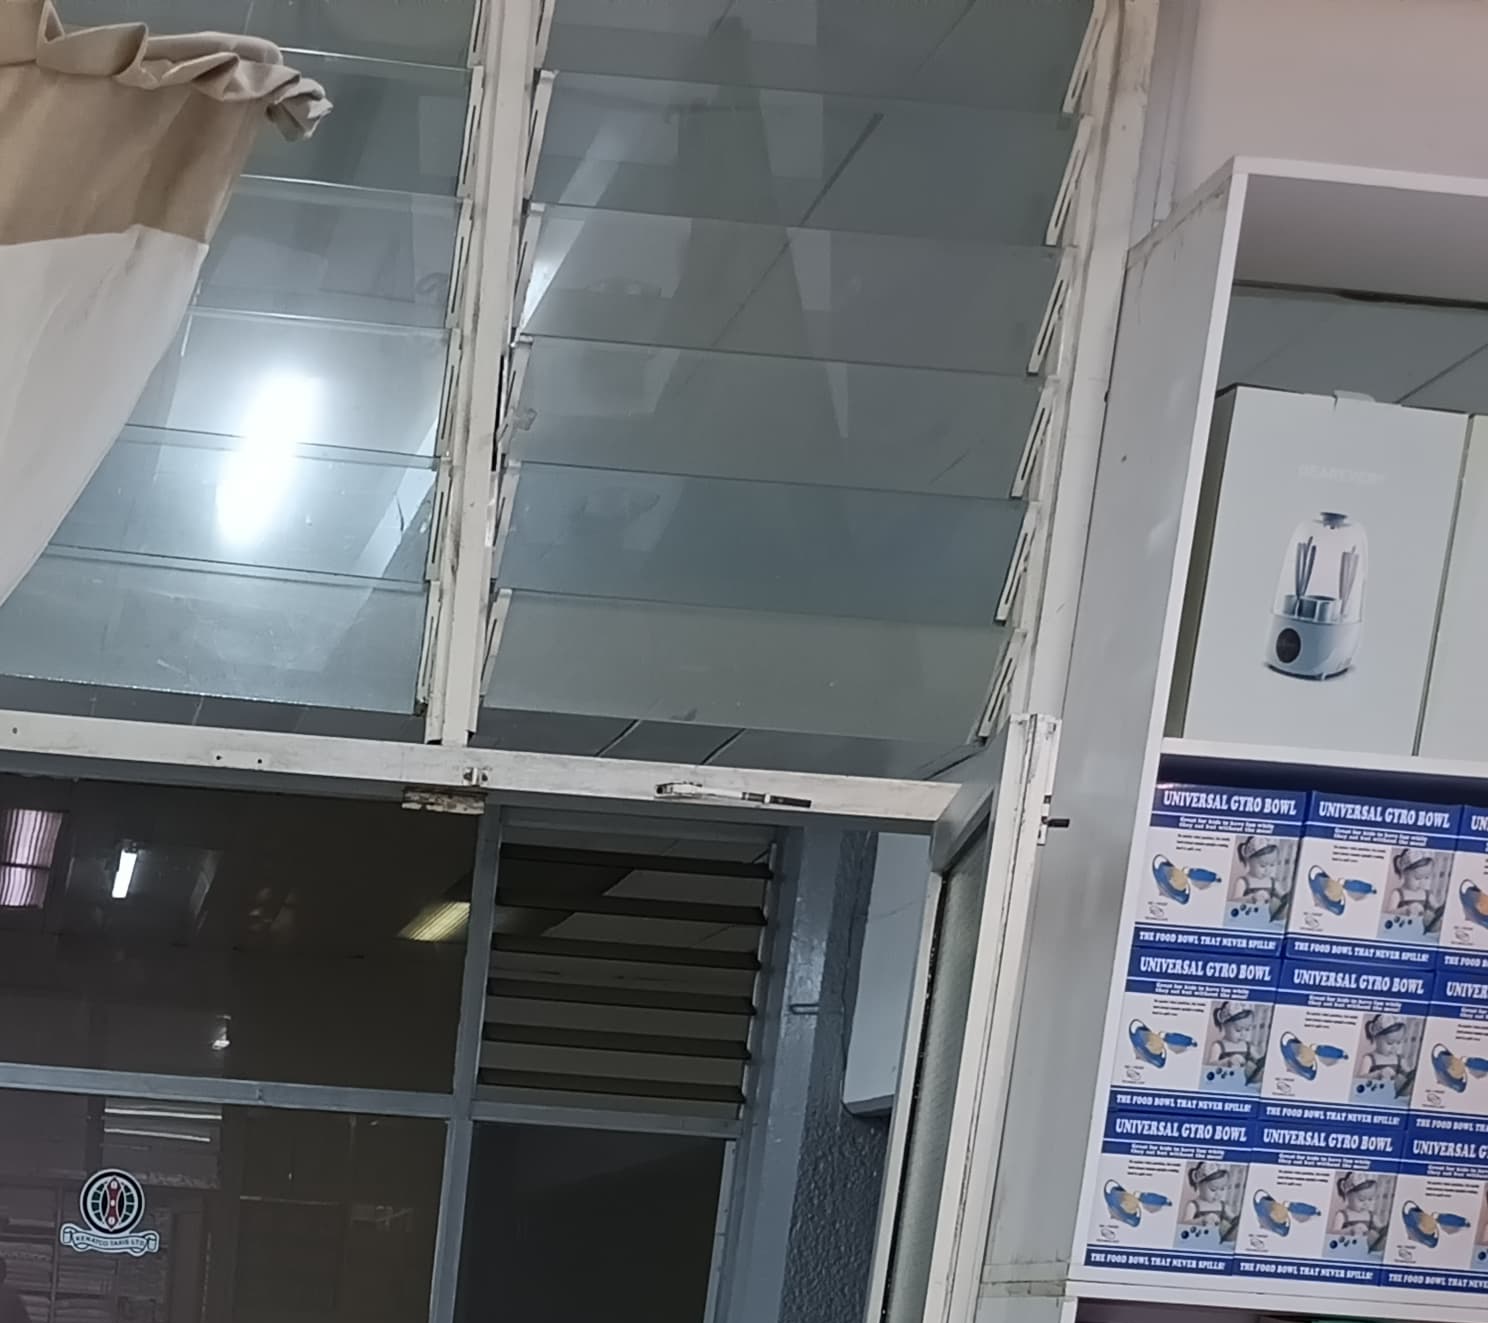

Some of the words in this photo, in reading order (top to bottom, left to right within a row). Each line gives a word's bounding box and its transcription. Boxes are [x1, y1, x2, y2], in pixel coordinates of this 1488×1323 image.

[1163, 791, 1228, 810] UNIVERSAL
[1230, 796, 1262, 812] GYRO
[1263, 798, 1296, 815] BOWL
[1319, 801, 1383, 821] UNIVERSAL
[1385, 808, 1416, 824] GYRO
[1417, 811, 1450, 828] BOWL
[1139, 932, 1154, 941] THE
[1156, 933, 1176, 942] FOOD
[1177, 935, 1198, 944] BOWL
[1200, 936, 1220, 945] THAT
[1221, 938, 1247, 947] NEVER
[1294, 942, 1309, 951] THE
[1310, 943, 1330, 953] FOOD
[1332, 945, 1353, 955] BOWL
[1354, 947, 1374, 957] THAT
[1375, 949, 1400, 959] NEVER
[1140, 957, 1204, 976] UNIVERSAL
[1206, 962, 1237, 978] GYRO
[1238, 964, 1271, 981] BOWL
[1293, 969, 1357, 988] UNIVERSAL
[1359, 974, 1390, 991] GYRO
[1392, 977, 1424, 994] BOWL
[1447, 982, 1488, 999] UNIVER
[1117, 1095, 1131, 1104] THE
[1133, 1096, 1153, 1105] FOOD
[1154, 1097, 1175, 1107] BOWL
[1177, 1099, 1196, 1108] THAT
[1197, 1101, 1223, 1110] NEVER
[1266, 1107, 1280, 1116] THE
[1282, 1108, 1302, 1118] FOOD
[1303, 1110, 1324, 1119] BOWL
[1326, 1111, 1345, 1121] THAT
[1346, 1113, 1372, 1123] NEVER
[1115, 1118, 1180, 1137] UNIVERSAL
[1181, 1124, 1213, 1139] GYRO
[1214, 1126, 1247, 1142] BOWL
[1476, 1123, 1488, 1132] THA
[1263, 1129, 1326, 1147] UNIVERSAL
[1328, 1134, 1359, 1149] GYRO
[1361, 1136, 1393, 1152] BOWL
[1413, 1140, 1476, 1158] UNIVERSAL
[1091, 1253, 1105, 1262] THE
[1107, 1254, 1127, 1264] FOOD
[1128, 1255, 1149, 1265] BOWL
[1150, 1257, 1170, 1266] THAT
[1171, 1258, 1196, 1268] NEVER
[1240, 1262, 1254, 1272] THE
[1255, 1264, 1276, 1273] FOOD
[1276, 1265, 1297, 1275] BOWL
[1299, 1267, 1318, 1276] THAT
[1319, 1269, 1344, 1278] NEVER
[1469, 1279, 1488, 1288] NEVE
